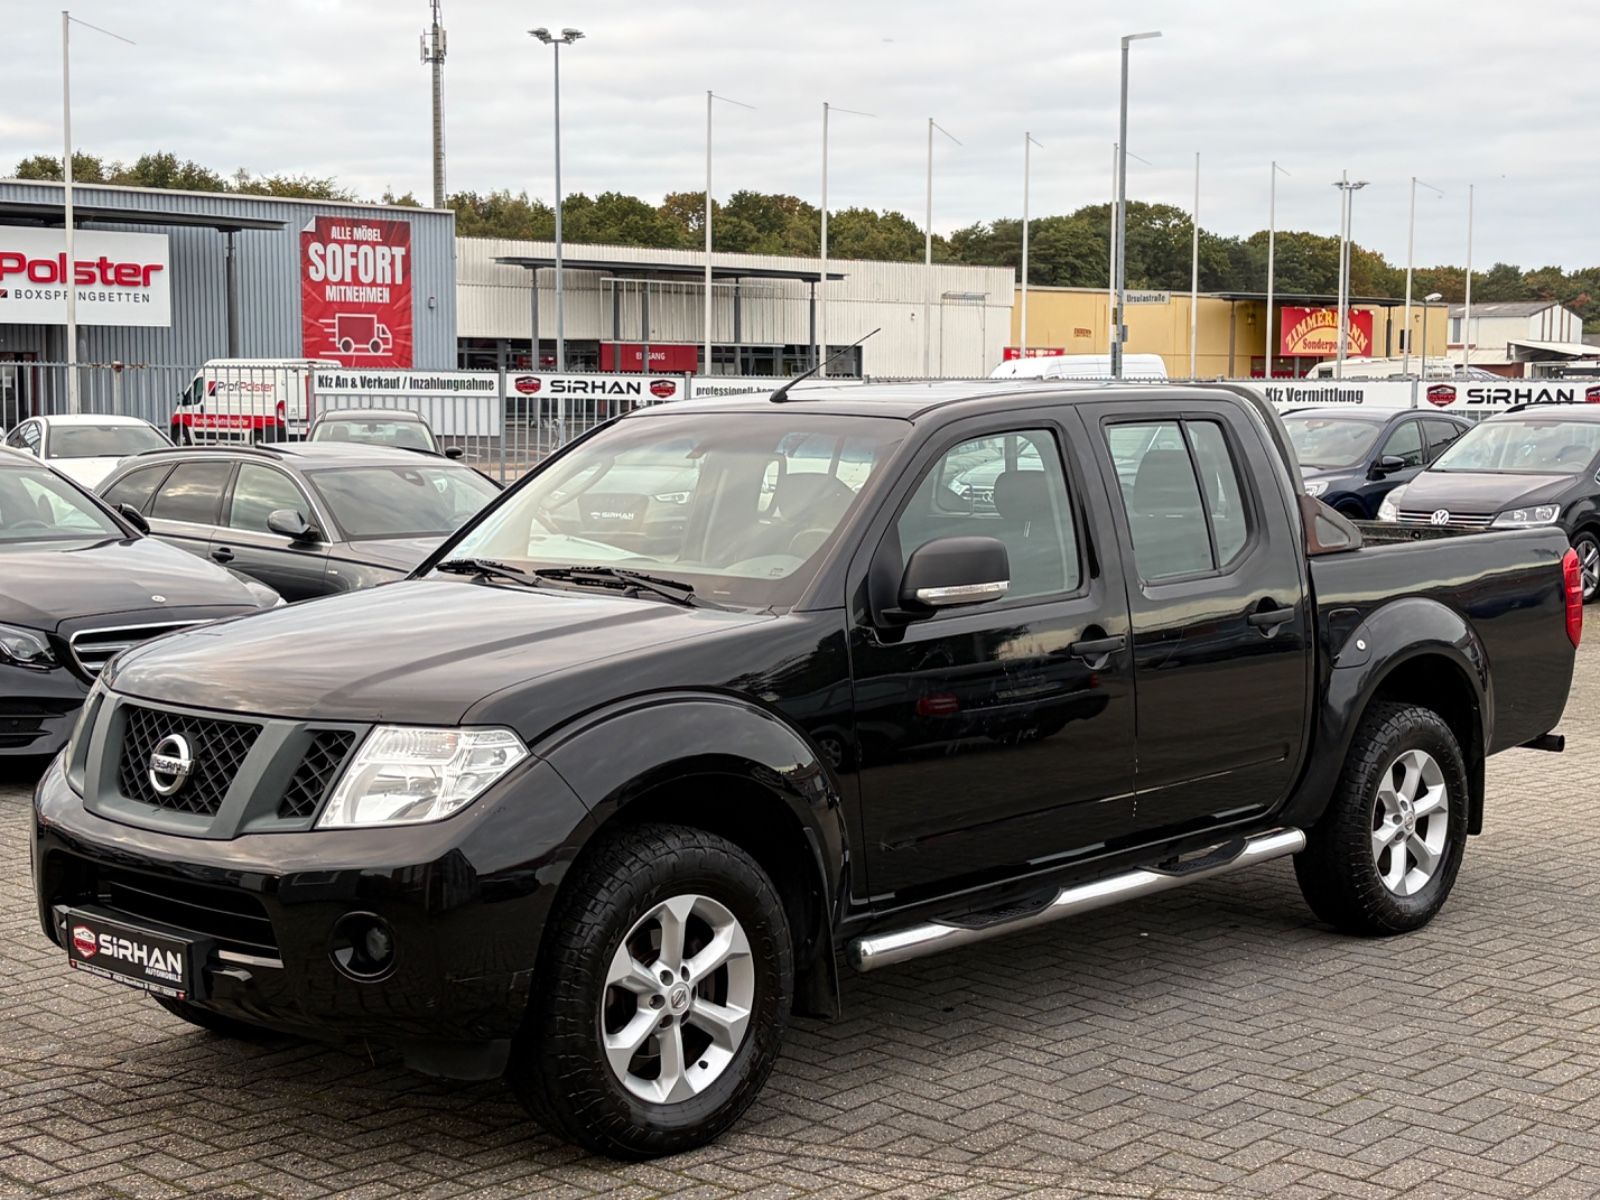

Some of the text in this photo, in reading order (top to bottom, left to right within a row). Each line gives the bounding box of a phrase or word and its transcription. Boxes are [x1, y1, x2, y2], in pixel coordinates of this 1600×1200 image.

[331, 224, 382, 242] ALLE MÖBEL
[308, 241, 406, 284] SOFORT
[14, 288, 150, 303] BOXSPRNGBETTEN
[325, 285, 390, 303] MITNEHMEN
[1285, 311, 1368, 352] ZIMMERNN
[1302, 338, 1353, 352] Sonderpon
[635, 351, 666, 361] EIGANG
[318, 375, 333, 388] Kfz
[335, 376, 348, 389] An
[350, 377, 357, 389] &
[360, 376, 400, 390] Verkauf
[409, 376, 495, 392] Inzahlungnahme
[1265, 387, 1364, 404] Kfz Vermittlung
